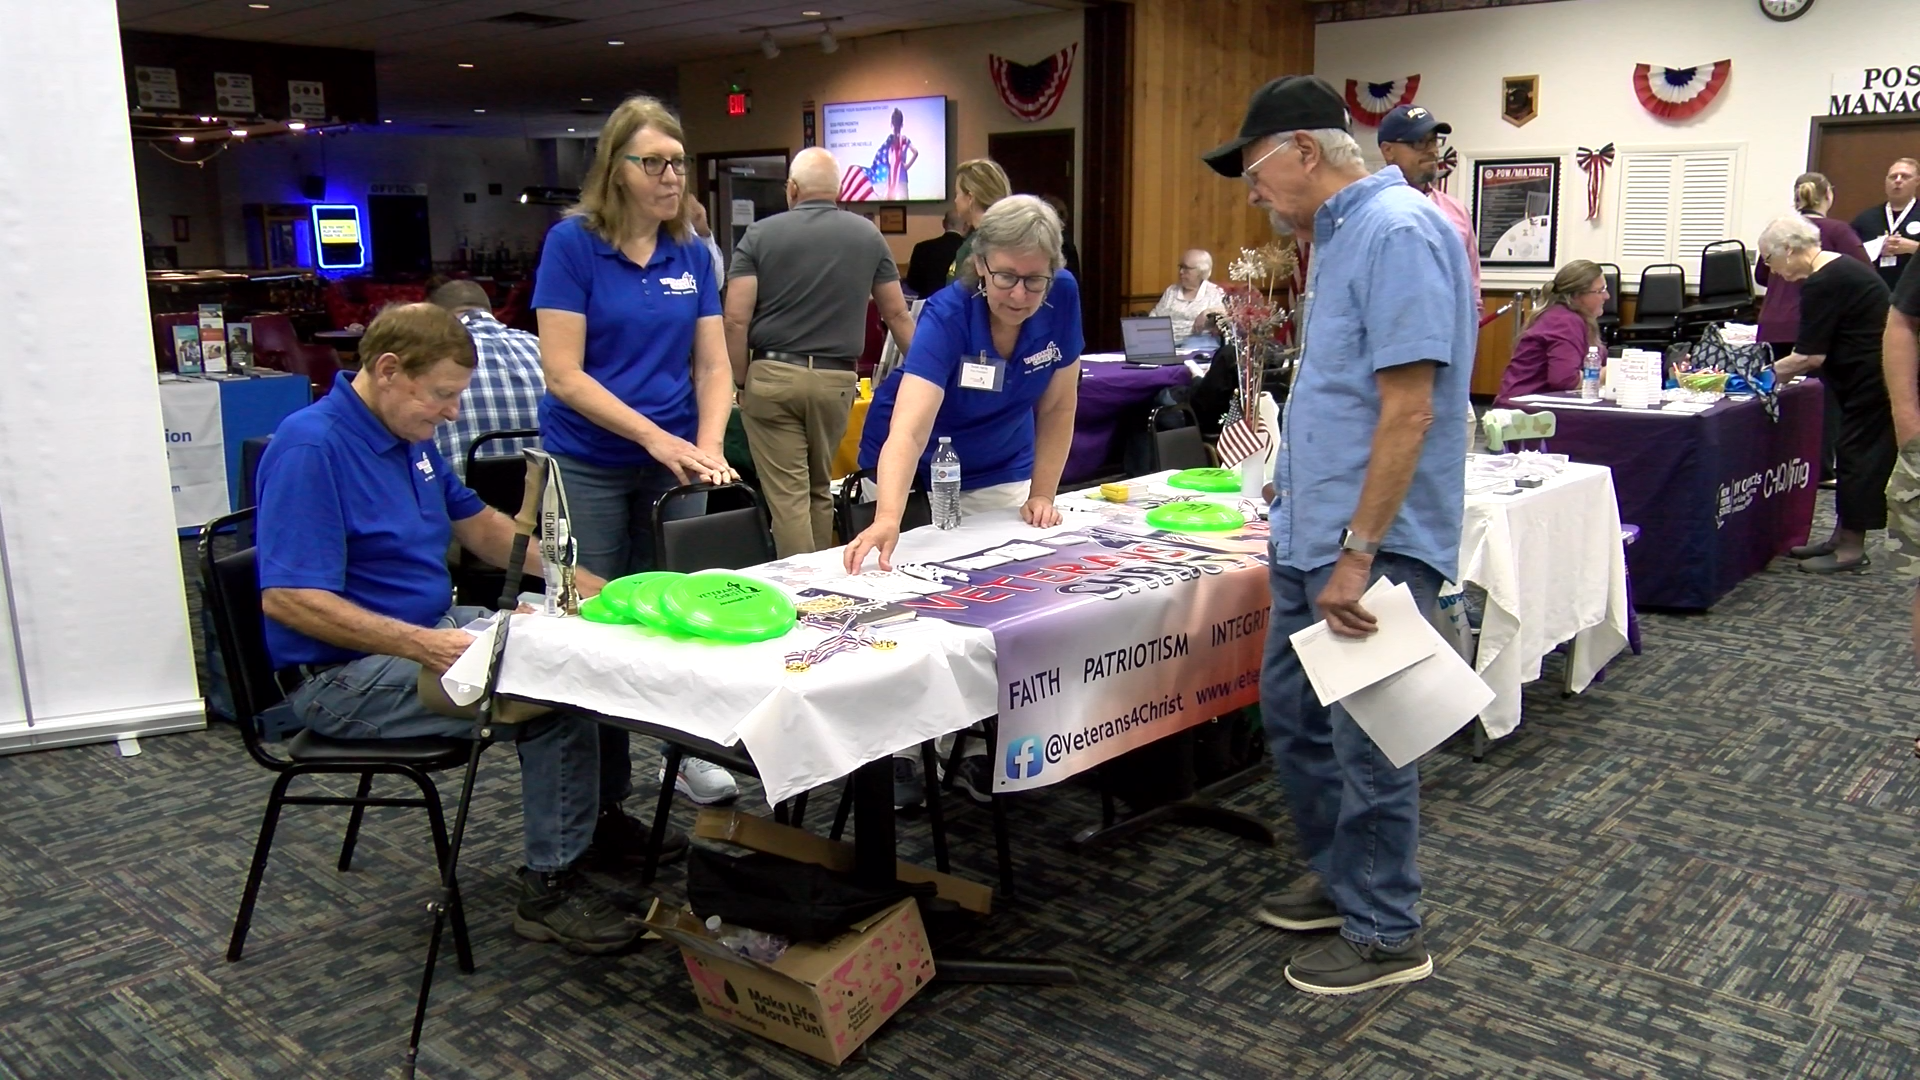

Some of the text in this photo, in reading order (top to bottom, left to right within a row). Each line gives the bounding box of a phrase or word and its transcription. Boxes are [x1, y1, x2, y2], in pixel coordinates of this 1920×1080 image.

[1528, 167, 1549, 177] TABLE
[1008, 667, 1061, 710] FAITH
[1083, 632, 1189, 684] PATRIOTISM
[1211, 605, 1271, 647] INTEGRIT
[1045, 692, 1184, 764] @Veterans4Christ
[747, 987, 817, 1023] Make Life
[753, 1002, 826, 1039] More Fun!
